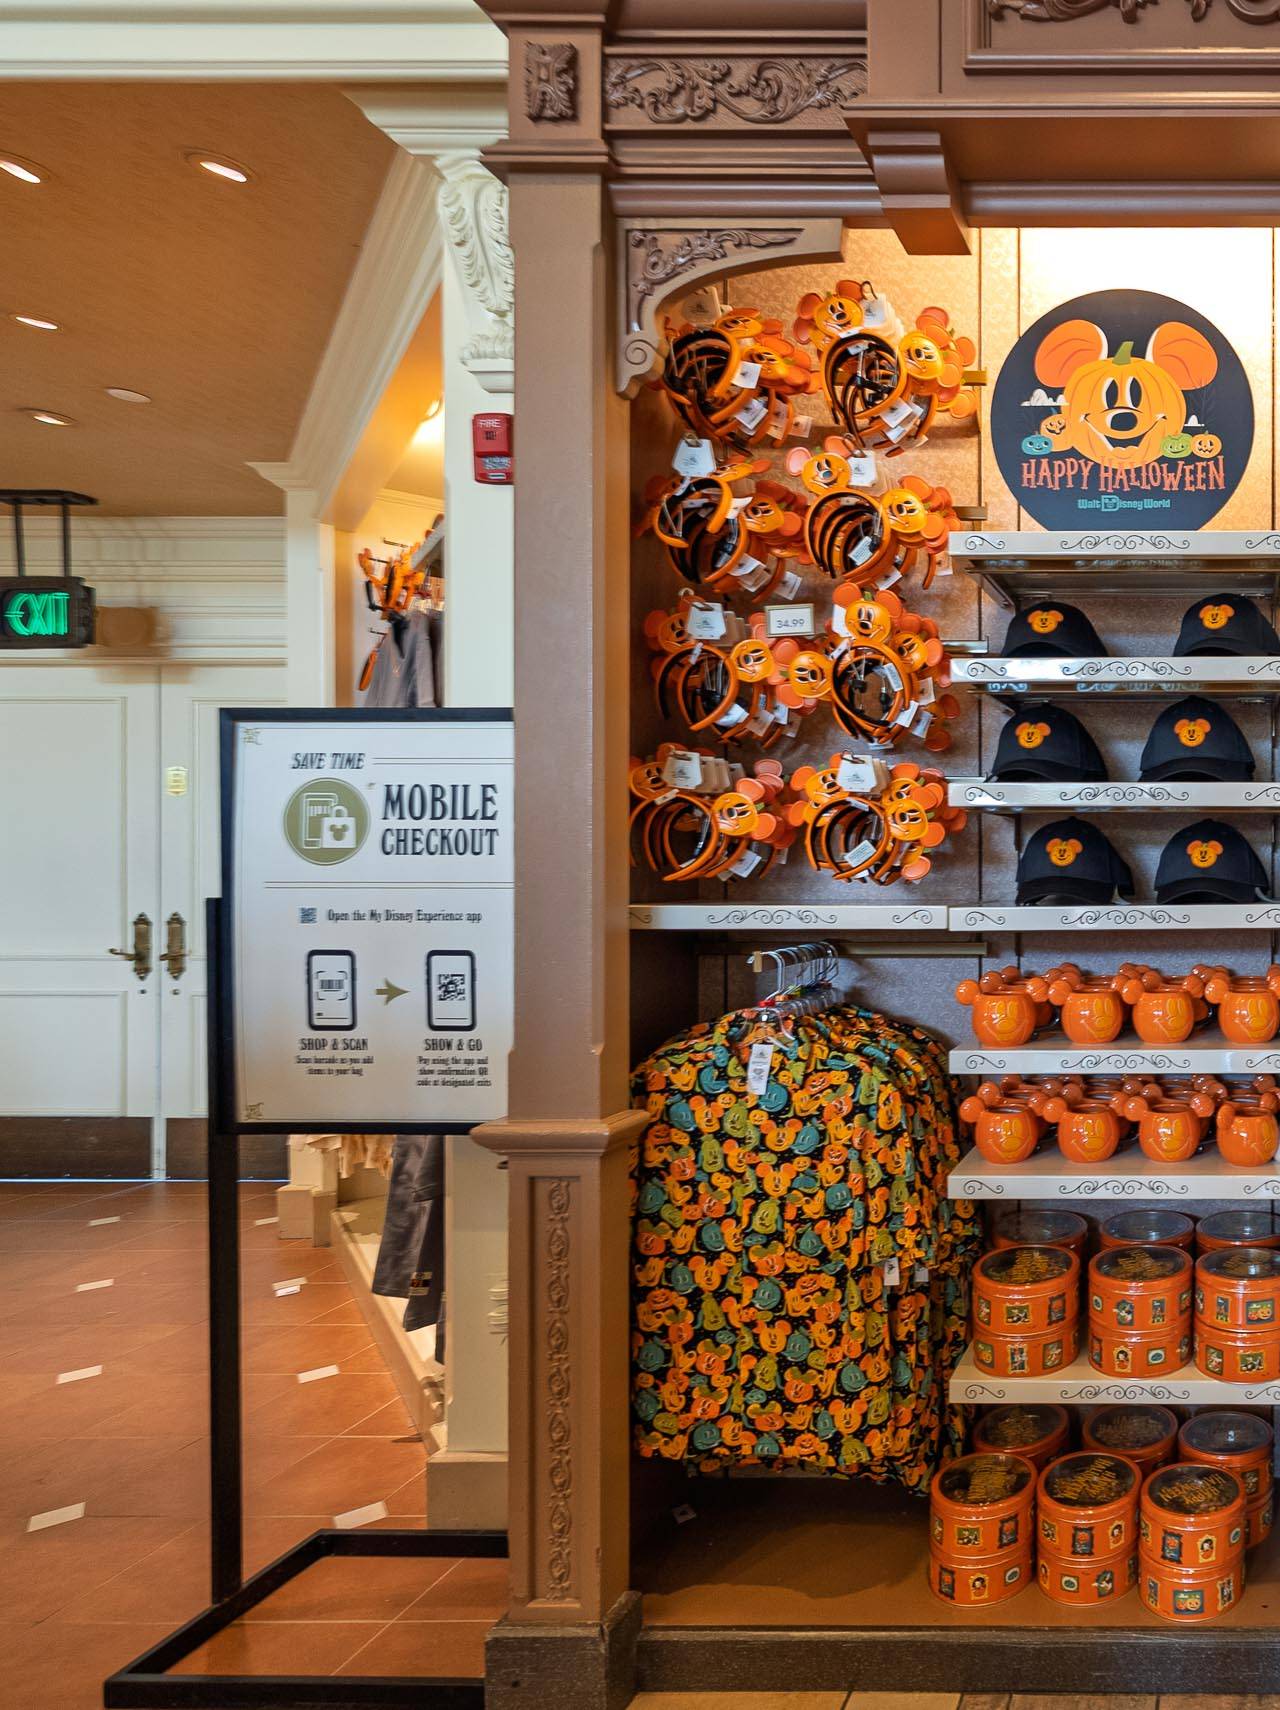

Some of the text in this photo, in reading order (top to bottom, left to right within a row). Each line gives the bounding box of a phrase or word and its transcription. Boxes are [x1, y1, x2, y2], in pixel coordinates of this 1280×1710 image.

[1021, 454, 1226, 492] HAPPY HALLOWEEN
[1078, 495, 1171, 511] Walt Disney World
[6, 592, 70, 636] EXIT
[776, 618, 805, 628] 34.99
[291, 752, 366, 769] SAVE TIME
[381, 783, 499, 821] MOBILE
[381, 828, 499, 856] CHECKOUT
[327, 908, 483, 923] Open the My Disney Experience app
[300, 1038, 369, 1051] SHOP & SCAN
[424, 1038, 483, 1051] SHOW & GO
